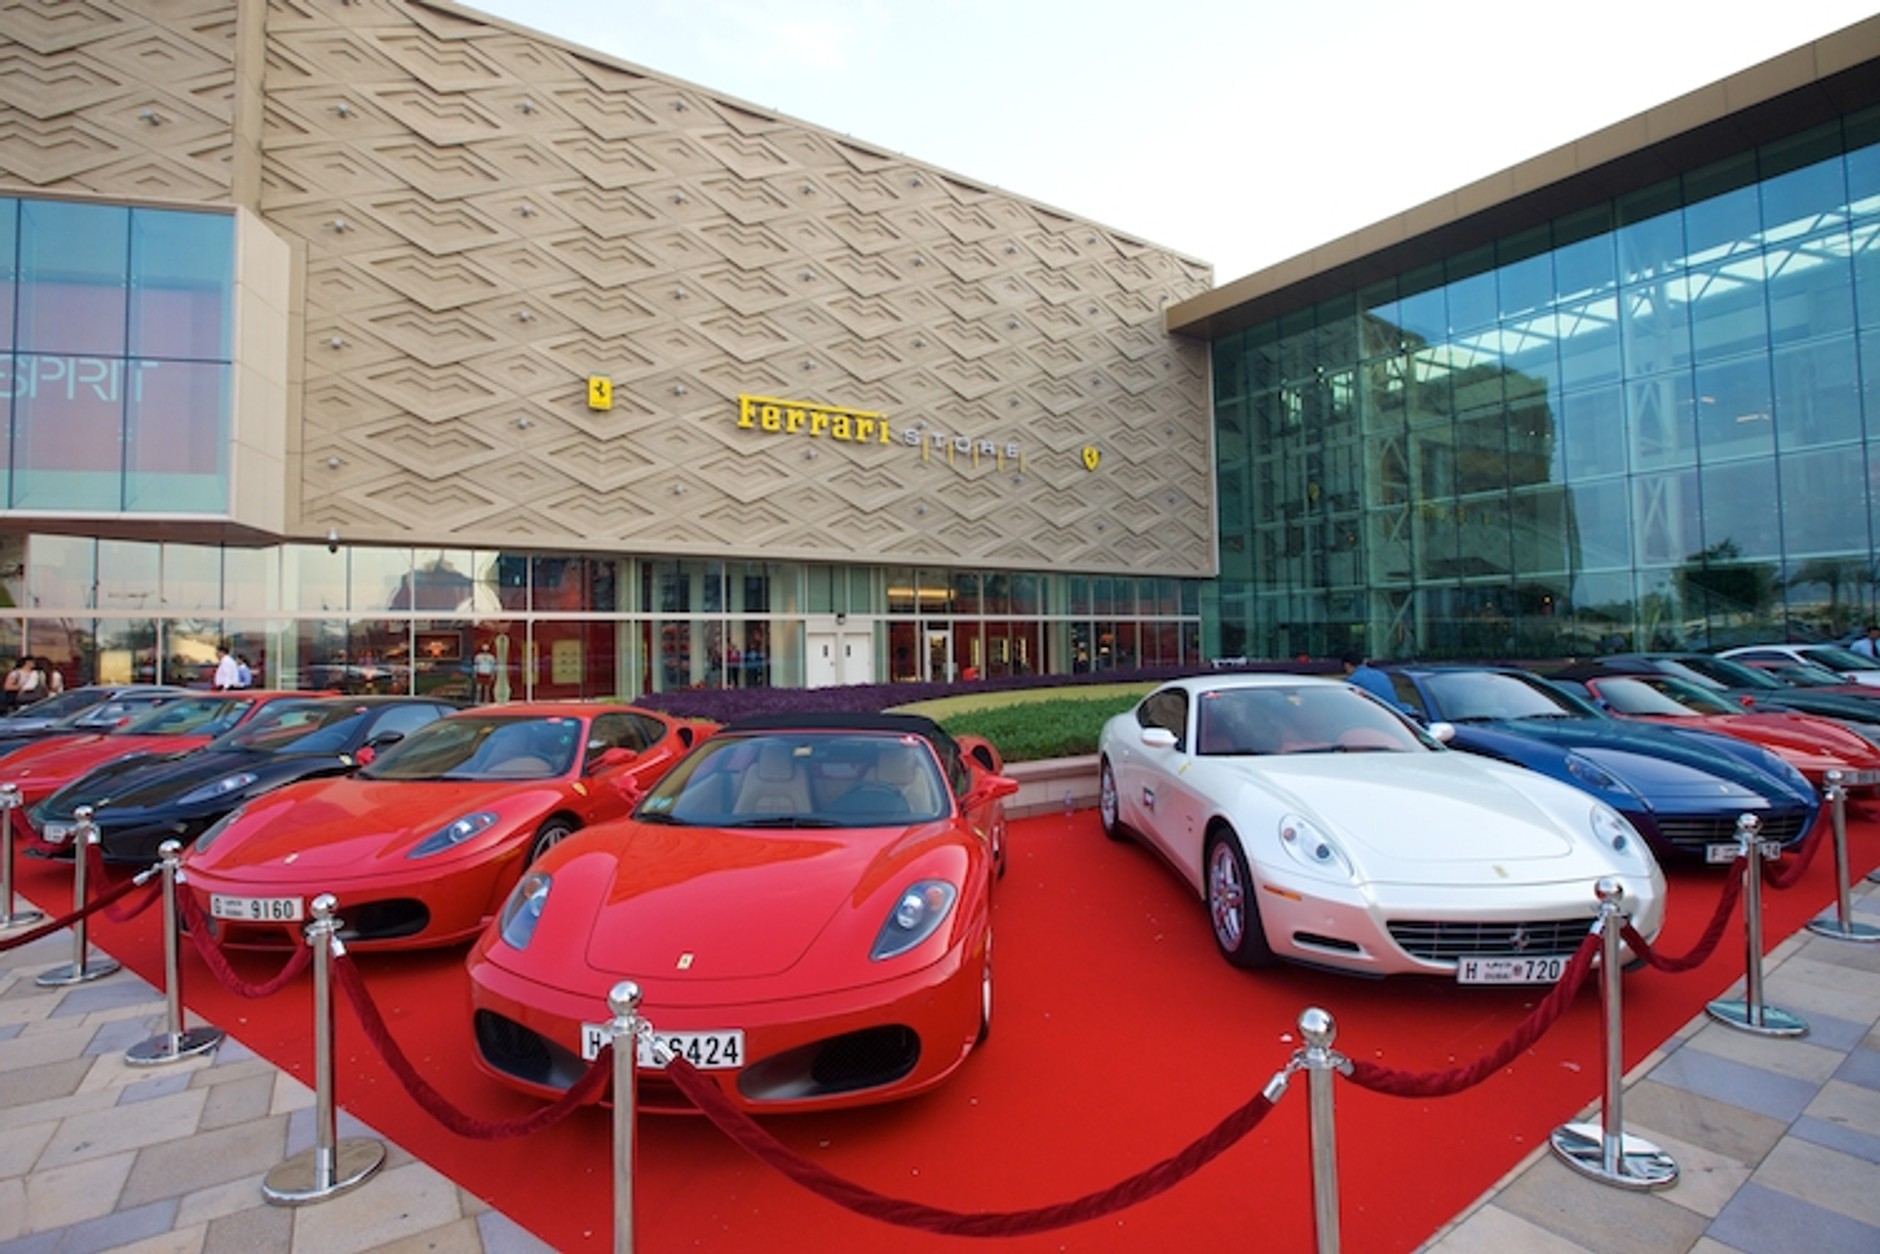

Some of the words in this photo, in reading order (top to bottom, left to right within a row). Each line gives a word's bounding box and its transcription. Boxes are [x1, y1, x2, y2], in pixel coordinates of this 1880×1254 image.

[0, 352, 159, 402] SPRIT
[737, 393, 891, 445] Ferrari
[904, 428, 1018, 459] STORE
[251, 900, 294, 918] 9160
[1466, 962, 1477, 979] H
[1525, 960, 1569, 979] 720
[589, 1030, 600, 1055] H
